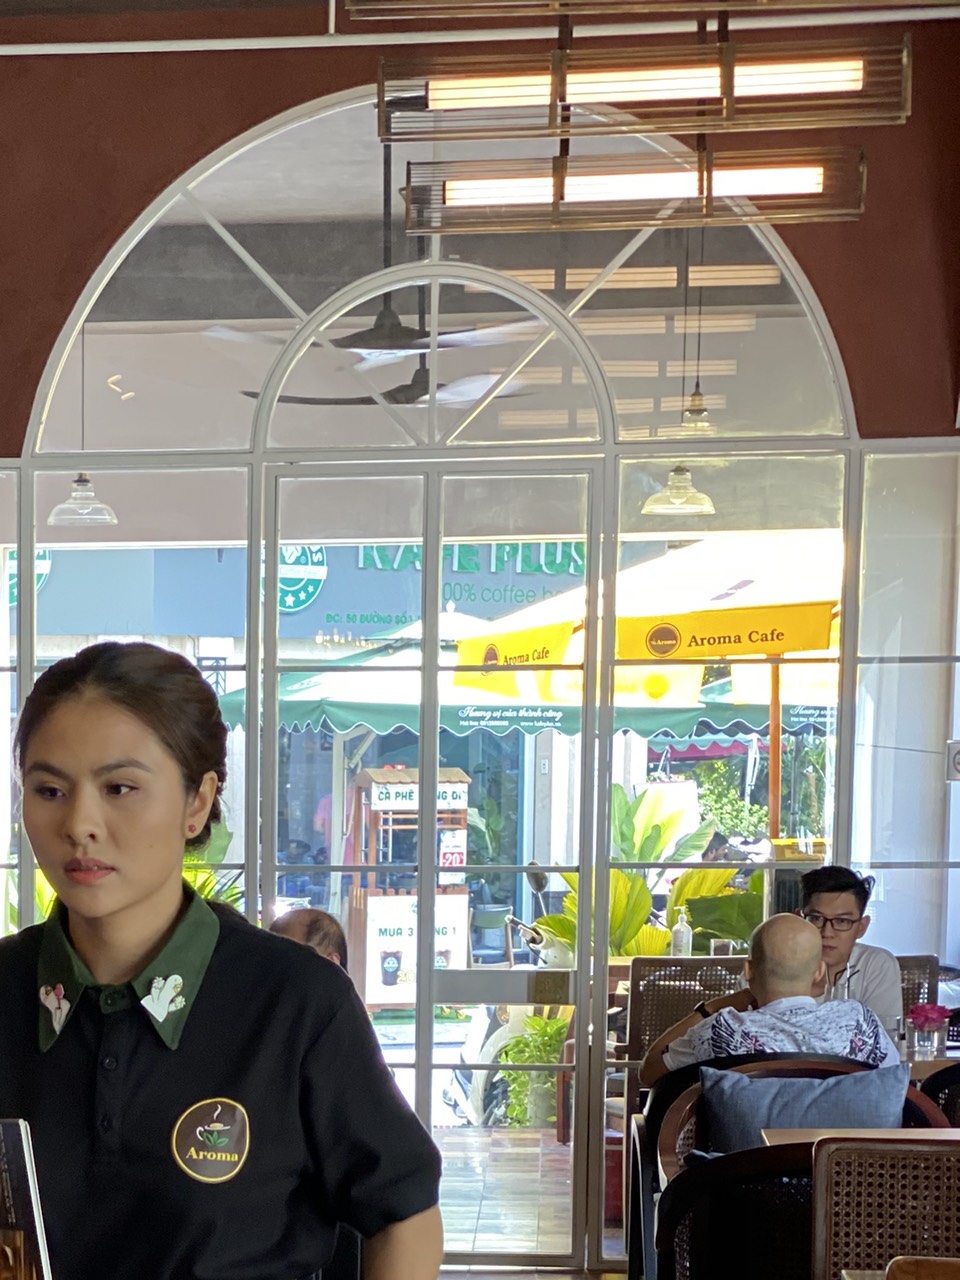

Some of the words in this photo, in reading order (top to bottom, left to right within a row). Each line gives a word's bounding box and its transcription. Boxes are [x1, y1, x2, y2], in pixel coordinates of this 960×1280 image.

[358, 544, 480, 573] KAE
[442, 582, 476, 602] 00%
[481, 584, 536, 602] coffee
[687, 634, 741, 648] Aroma
[748, 628, 785, 643] Cafe
[503, 652, 530, 665] Aroma
[532, 646, 550, 661] Cafe
[378, 927, 403, 937] MUA
[408, 927, 414, 937] 3
[435, 926, 448, 936] NG
[185, 1146, 239, 1161] Aroma
